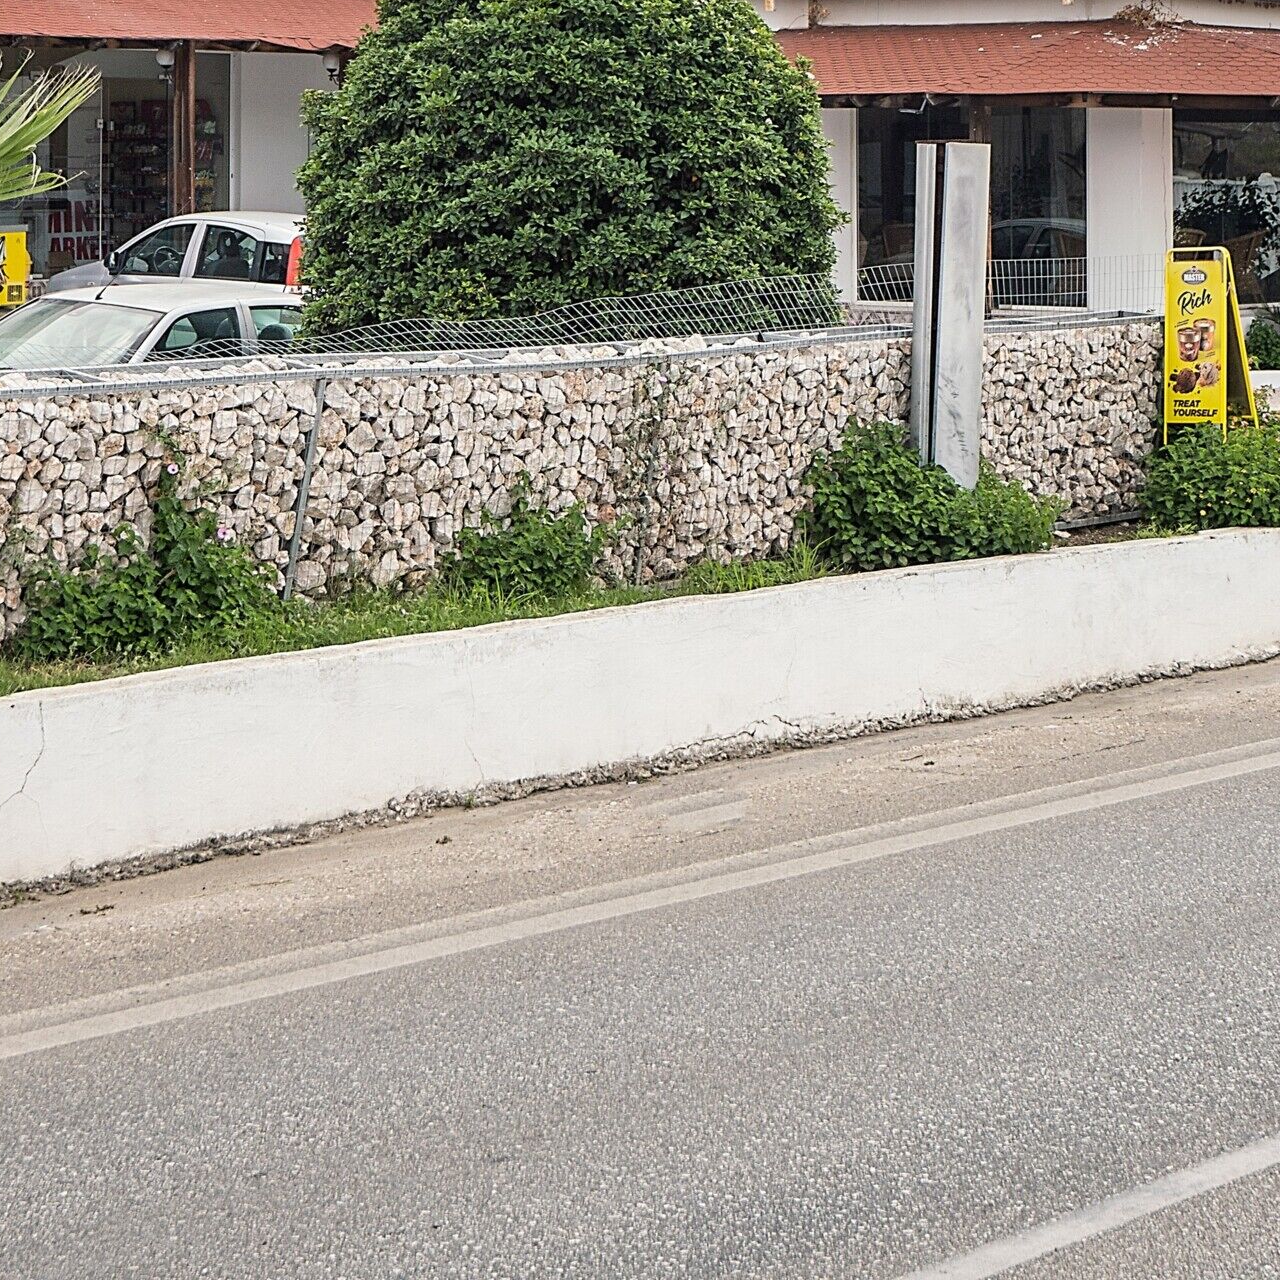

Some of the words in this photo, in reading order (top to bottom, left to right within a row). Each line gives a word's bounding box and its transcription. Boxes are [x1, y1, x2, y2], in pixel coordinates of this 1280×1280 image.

[1177, 288, 1212, 316] Rich
[1173, 399, 1201, 408] TREAT
[1173, 409, 1218, 417] YOURSELF
